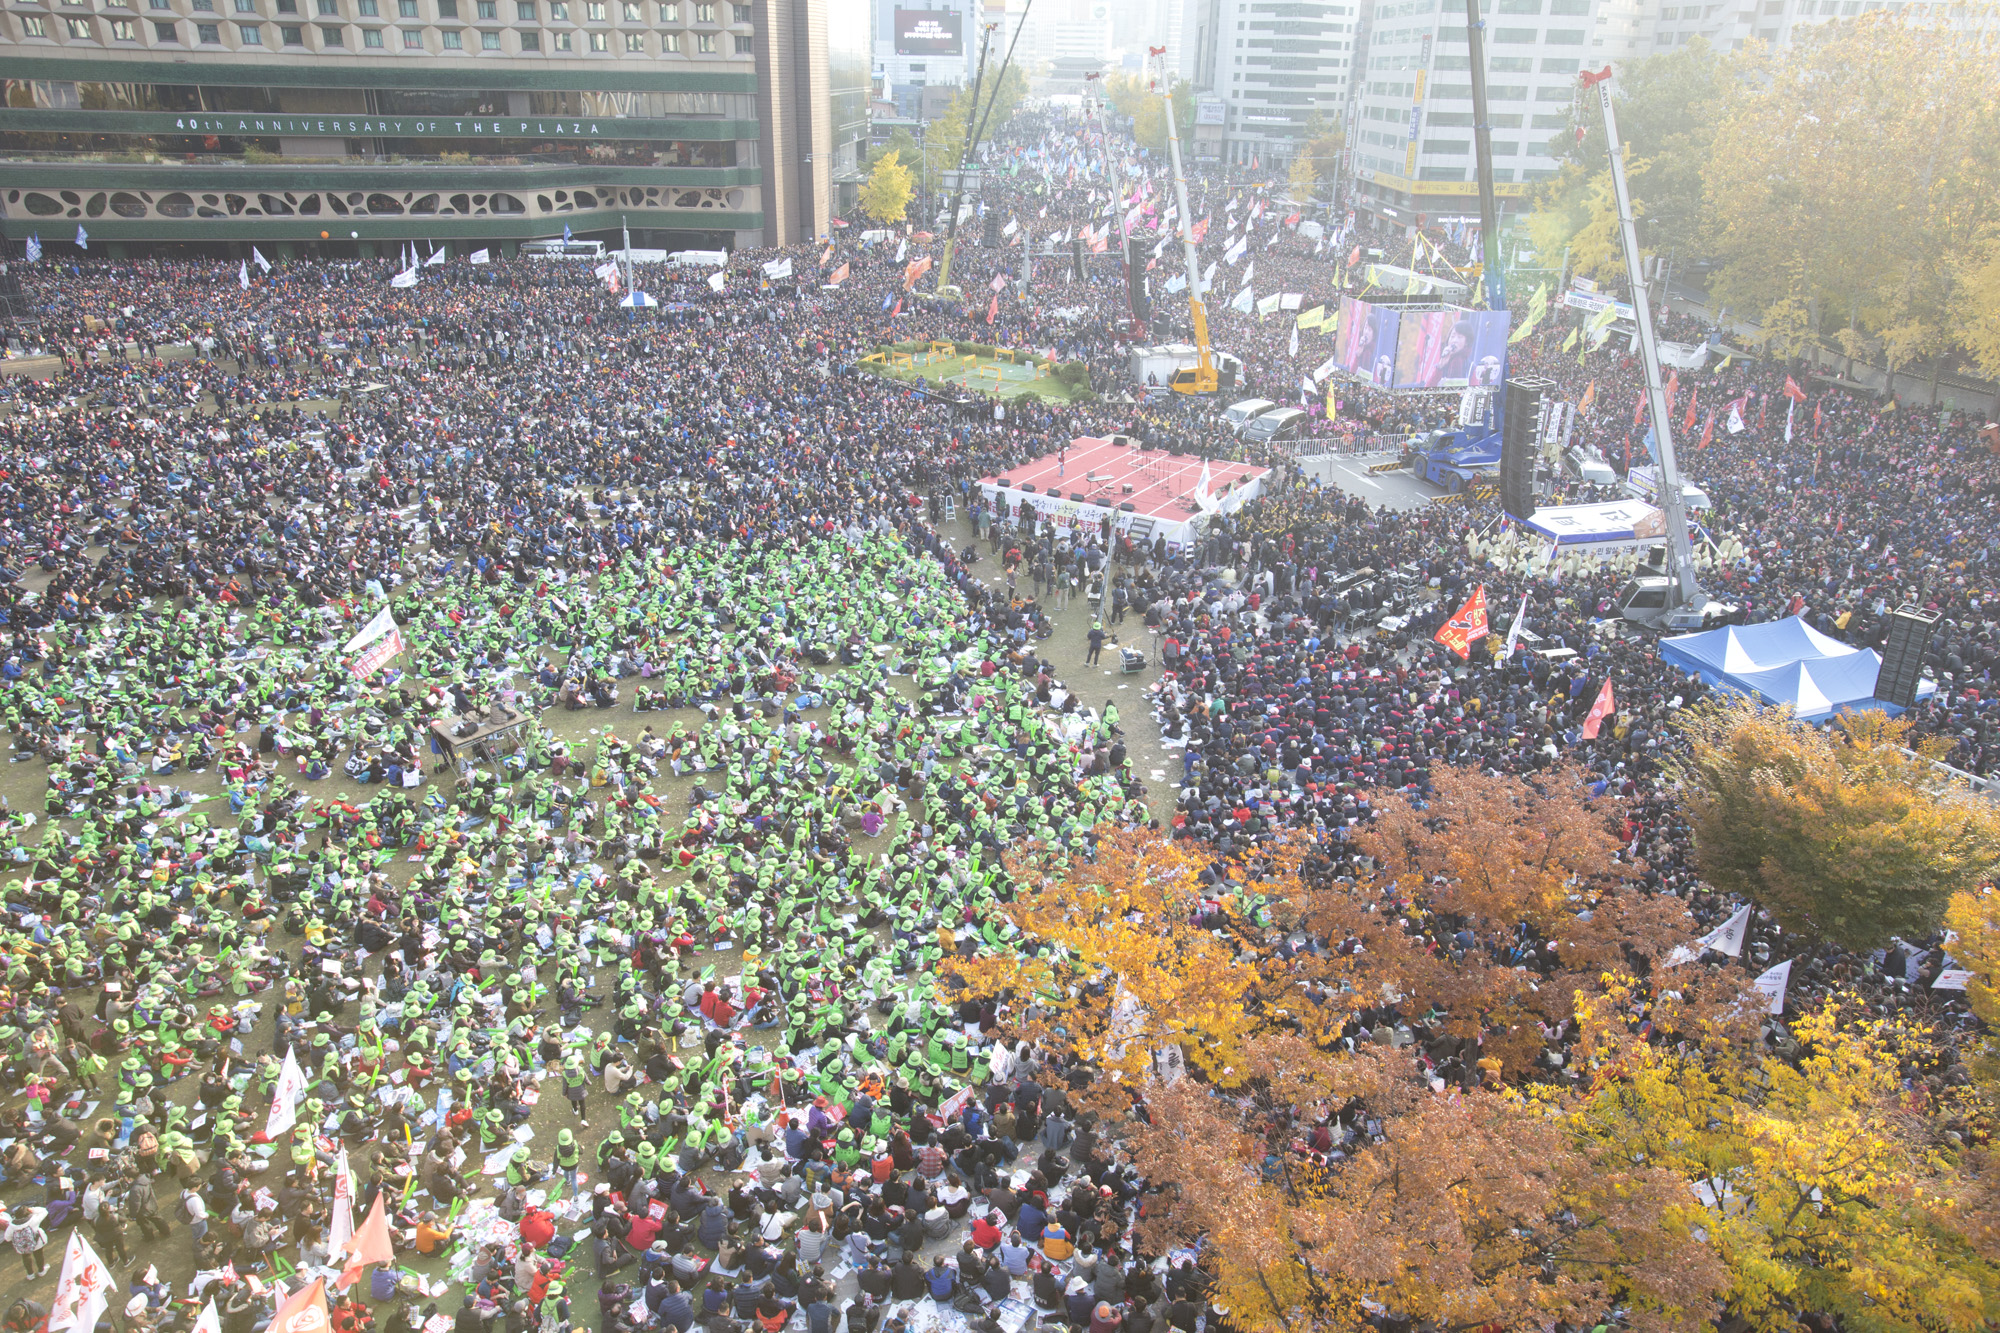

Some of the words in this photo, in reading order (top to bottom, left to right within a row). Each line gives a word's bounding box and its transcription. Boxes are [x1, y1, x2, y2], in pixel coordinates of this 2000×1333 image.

[1601, 85, 1610, 108] KATO
[176, 118, 224, 130] 40th
[239, 120, 402, 131] ANNIVERSARY
[416, 122, 436, 132] OF
[455, 122, 501, 133] THE
[520, 123, 599, 134] PLAZA
